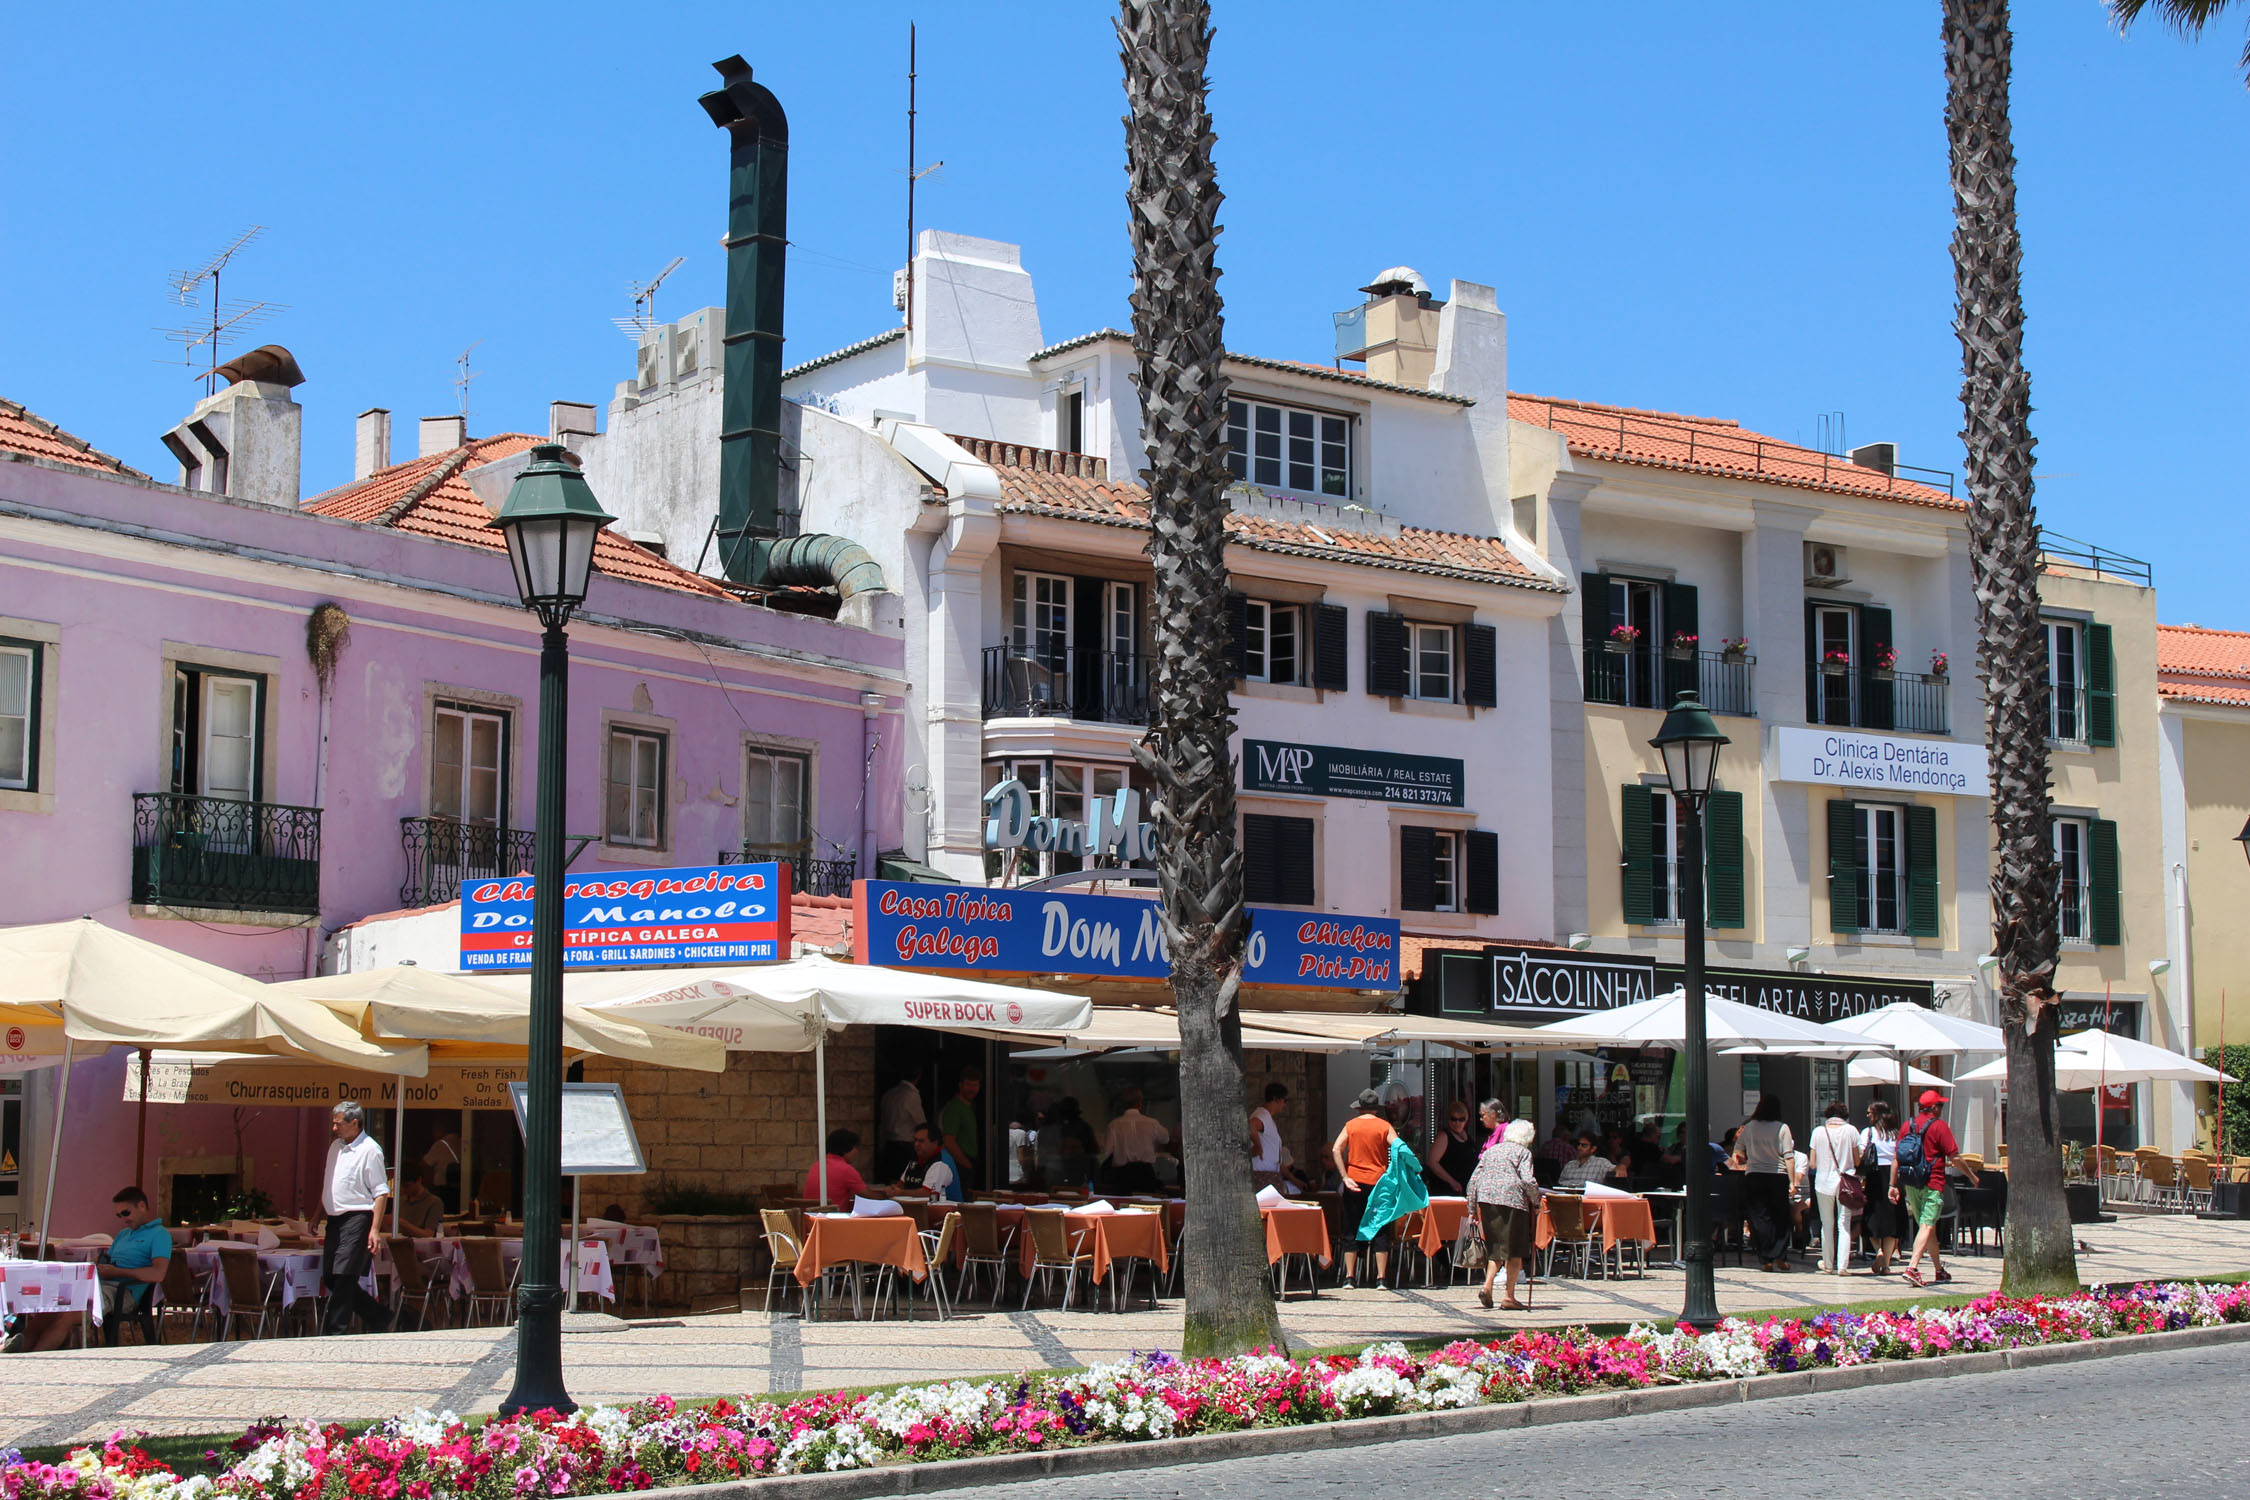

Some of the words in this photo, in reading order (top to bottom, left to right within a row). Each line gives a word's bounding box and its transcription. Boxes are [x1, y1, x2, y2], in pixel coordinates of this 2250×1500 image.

[1825, 737, 1878, 760] Clinica
[1884, 742, 1949, 766] Dentária
[1256, 745, 1314, 784] MAP
[1328, 763, 1383, 777] IMOBILIÁRIA
[1393, 769, 1416, 781] REAL
[1419, 771, 1452, 784] ESTATE
[1813, 758, 1834, 777] Dr.
[1839, 760, 1884, 781] Alexis
[1889, 764, 1966, 790] Mendonça
[1329, 786, 1383, 797] www.mapcascais.com
[1385, 786, 1400, 798] 214
[1402, 788, 1418, 800] 821
[1420, 790, 1452, 803] 373/74
[983, 779, 1095, 857] Dom
[578, 902, 766, 924] Manolo
[880, 889, 942, 920] Casa
[945, 892, 1012, 925] Típica
[569, 930, 633, 943] TÍPICA
[639, 928, 719, 941] GALEGA
[896, 925, 999, 964] Galega
[1042, 901, 1120, 967] Dom
[1297, 921, 1391, 952] Chicken
[467, 953, 494, 964] VENDA
[496, 953, 507, 963] DE
[571, 949, 594, 961] FORA
[601, 949, 627, 961] GRILL
[630, 947, 676, 960] SARDINES
[684, 945, 727, 958] CHICKEN
[729, 945, 748, 957] PIRI
[751, 944, 771, 956] PIRI
[1298, 954, 1390, 982] Piri-Piri
[1502, 951, 1647, 1008] SACOLINHA
[904, 1001, 951, 1020] SUPER
[954, 1003, 996, 1021] BOCK
[2088, 1005, 2123, 1026] Hut
[164, 1067, 169, 1076] e
[173, 1066, 209, 1076] Pescados
[461, 1069, 489, 1079] Fresh
[495, 1069, 516, 1079] Fish
[158, 1079, 167, 1088] La
[171, 1079, 192, 1088] Brasa
[338, 1082, 372, 1100] Dom
[381, 1083, 444, 1101] Mnolo"
[476, 1083, 491, 1093] On
[174, 1091, 209, 1101] Mariscos
[463, 1096, 502, 1107] Saladas
